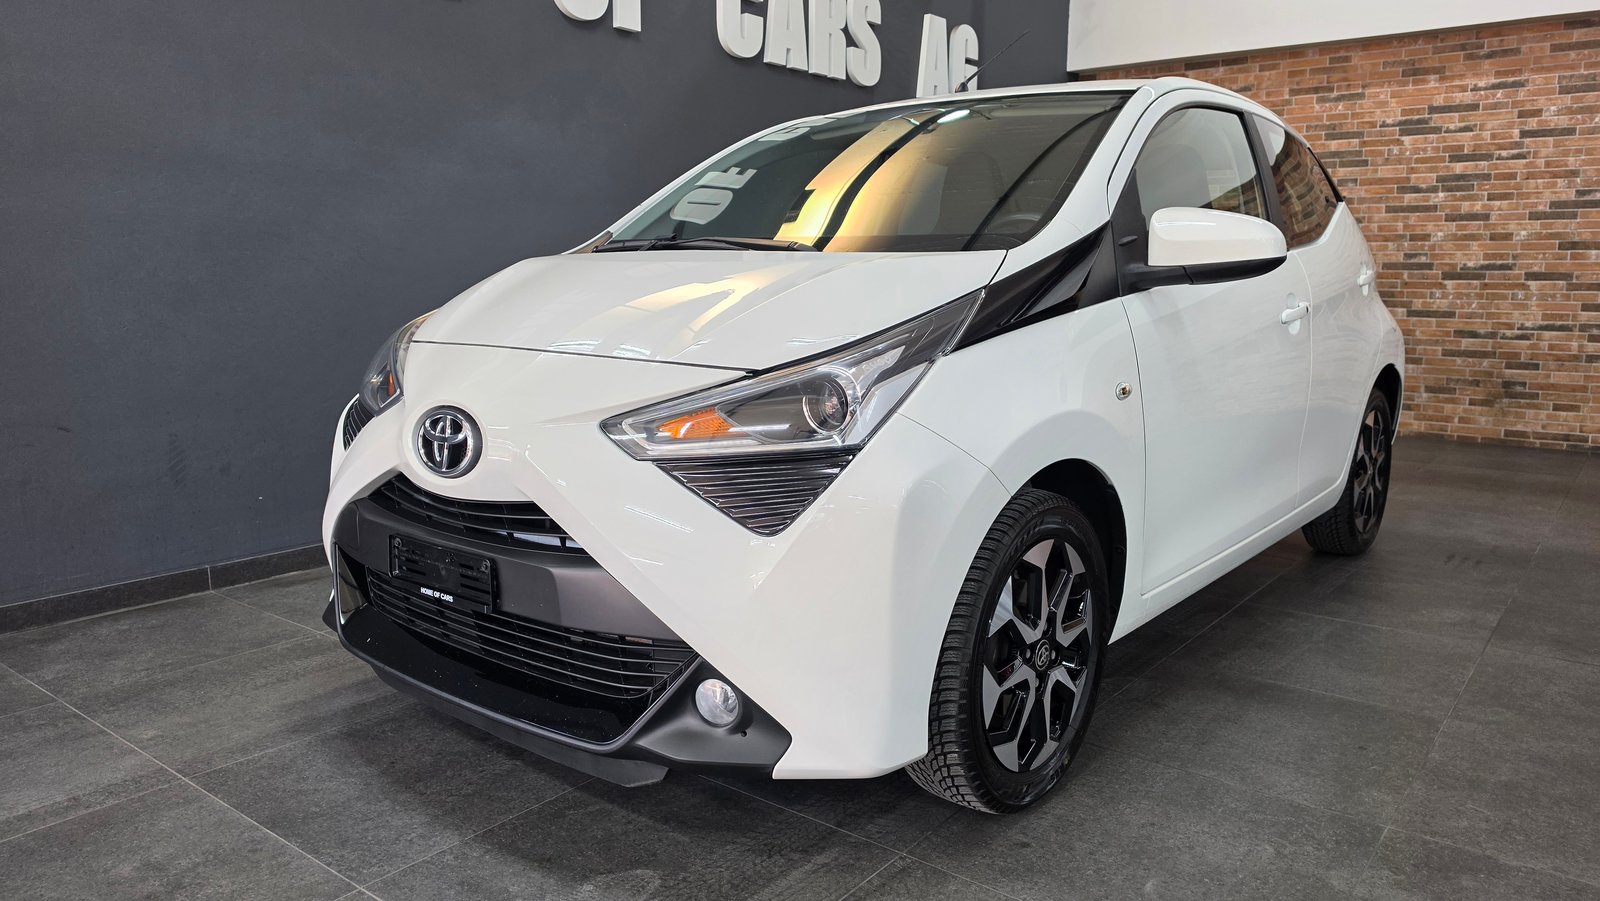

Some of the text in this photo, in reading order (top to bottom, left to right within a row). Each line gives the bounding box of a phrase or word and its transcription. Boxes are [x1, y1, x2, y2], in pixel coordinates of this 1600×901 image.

[716, 0, 979, 98] CARS AG
[420, 586, 434, 597] HOME
[440, 593, 454, 603] CARS
